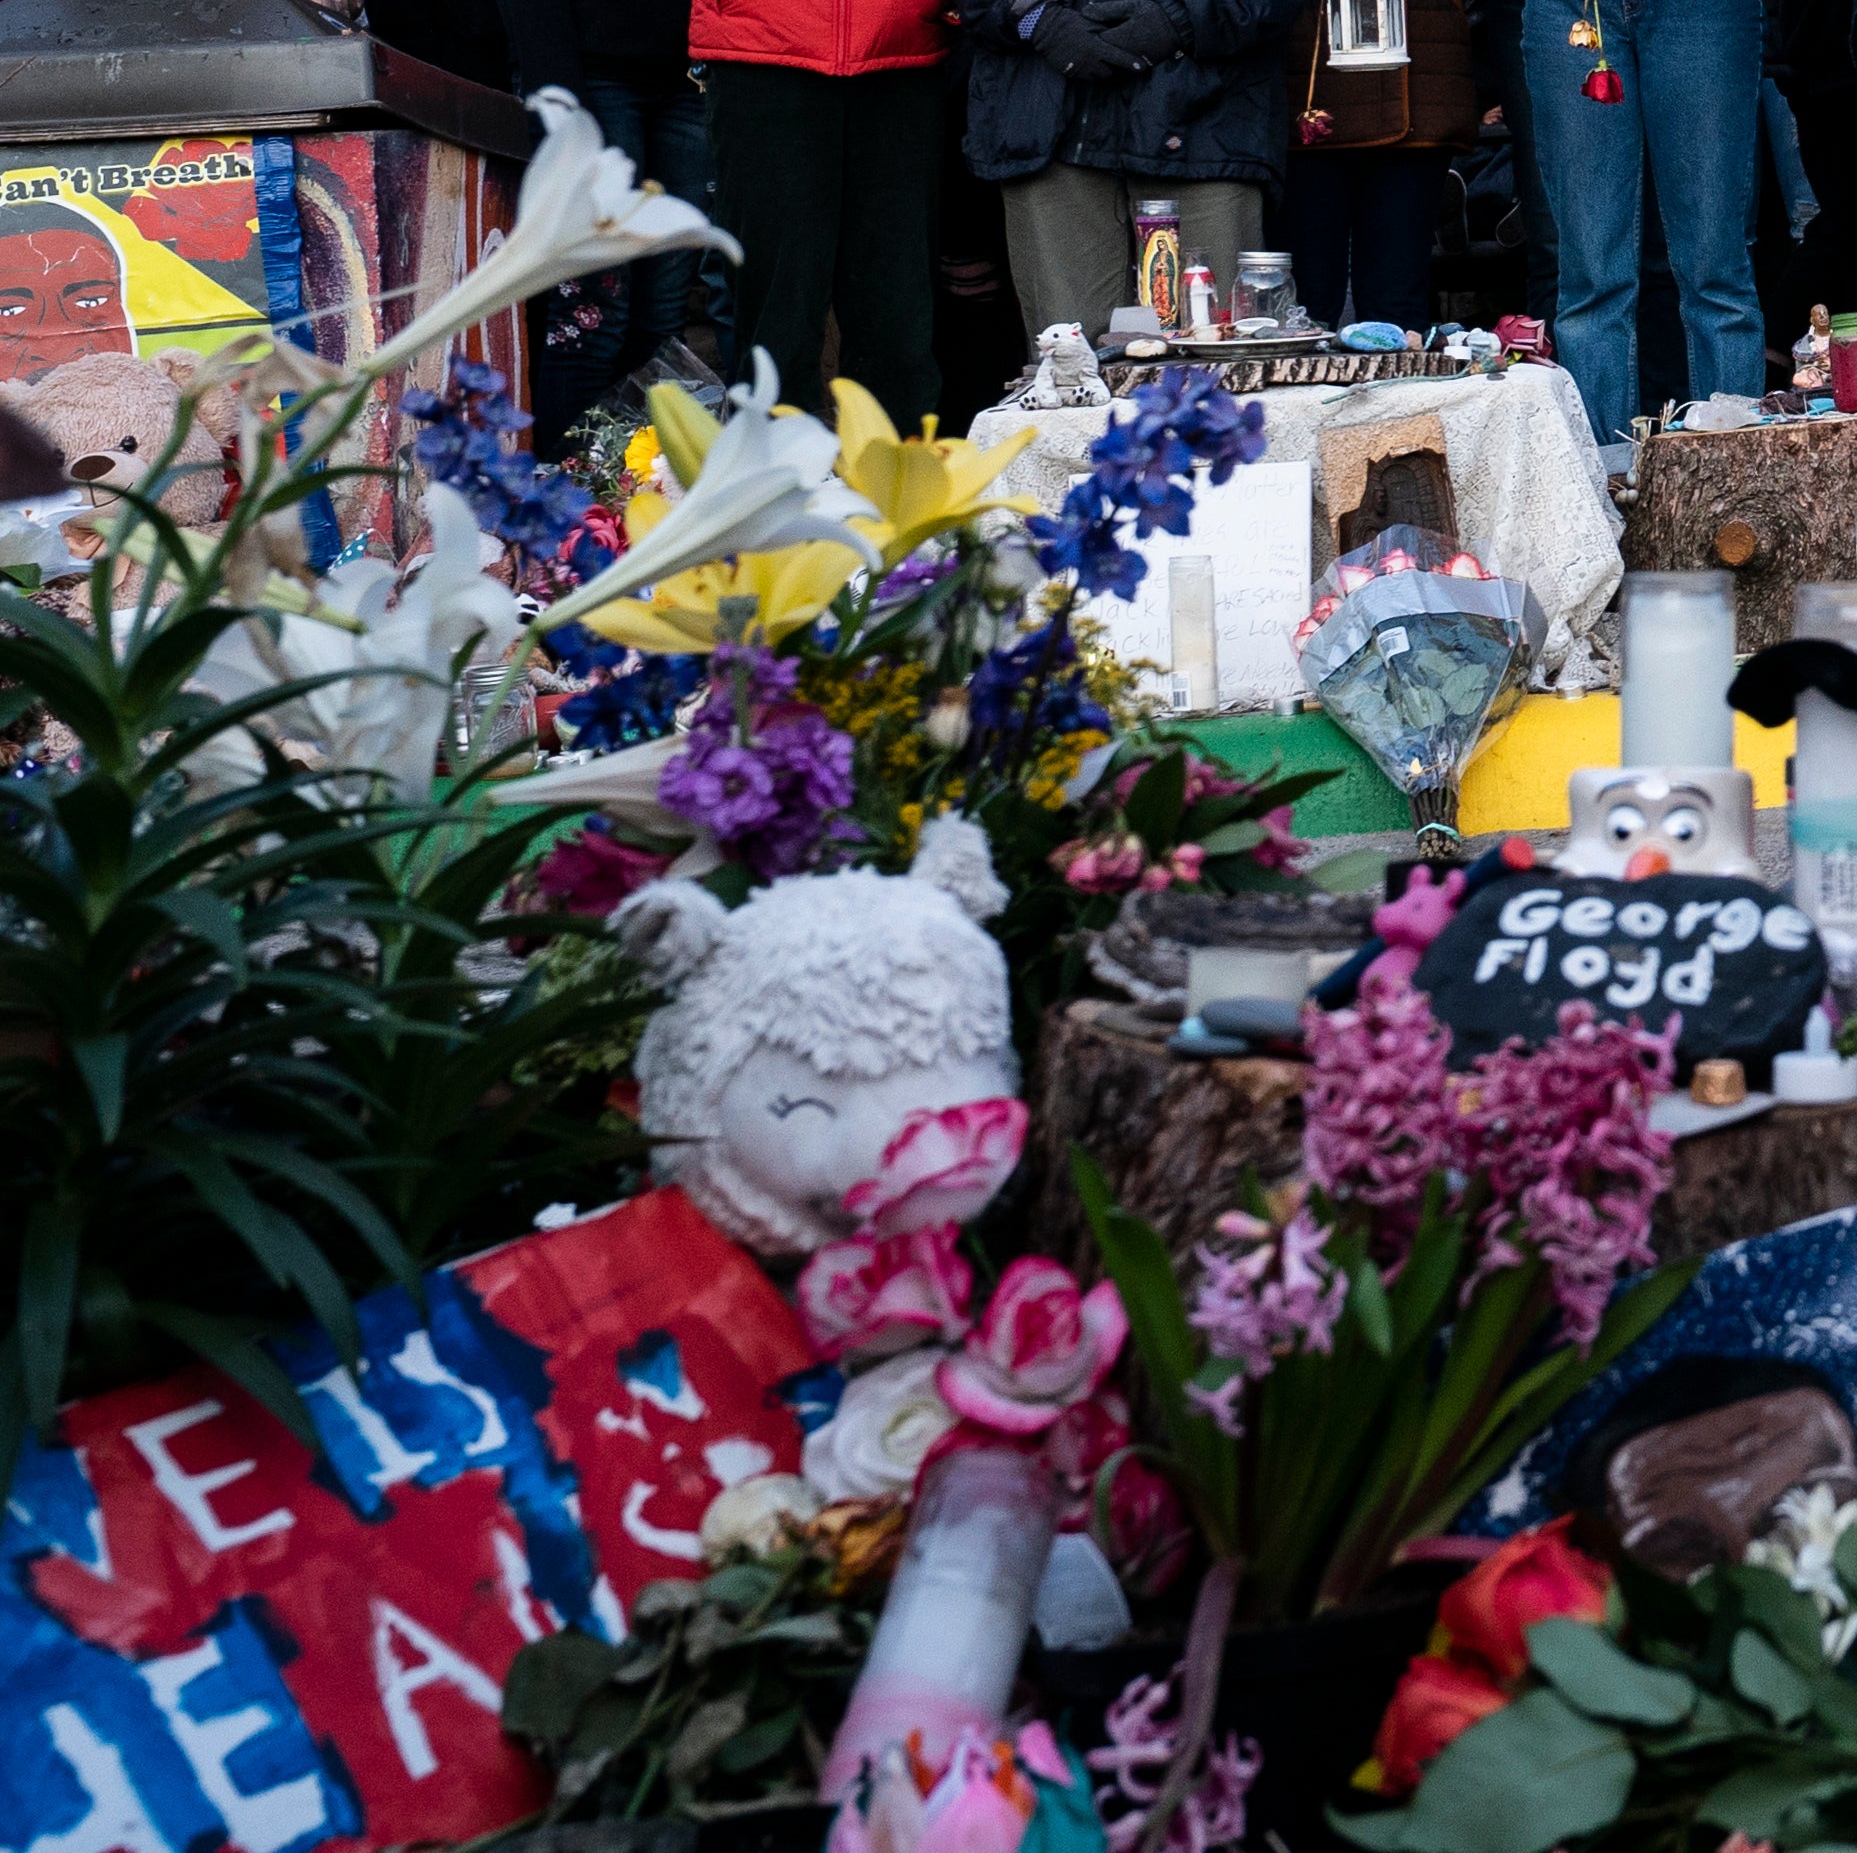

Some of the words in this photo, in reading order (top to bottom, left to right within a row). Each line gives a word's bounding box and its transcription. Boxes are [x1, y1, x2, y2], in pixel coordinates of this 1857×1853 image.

[0, 170, 90, 201] an't
[100, 154, 251, 192] Breath
[1098, 596, 1159, 623] lack
[1500, 888, 1813, 954] George
[1475, 937, 1715, 1009] Floyd
